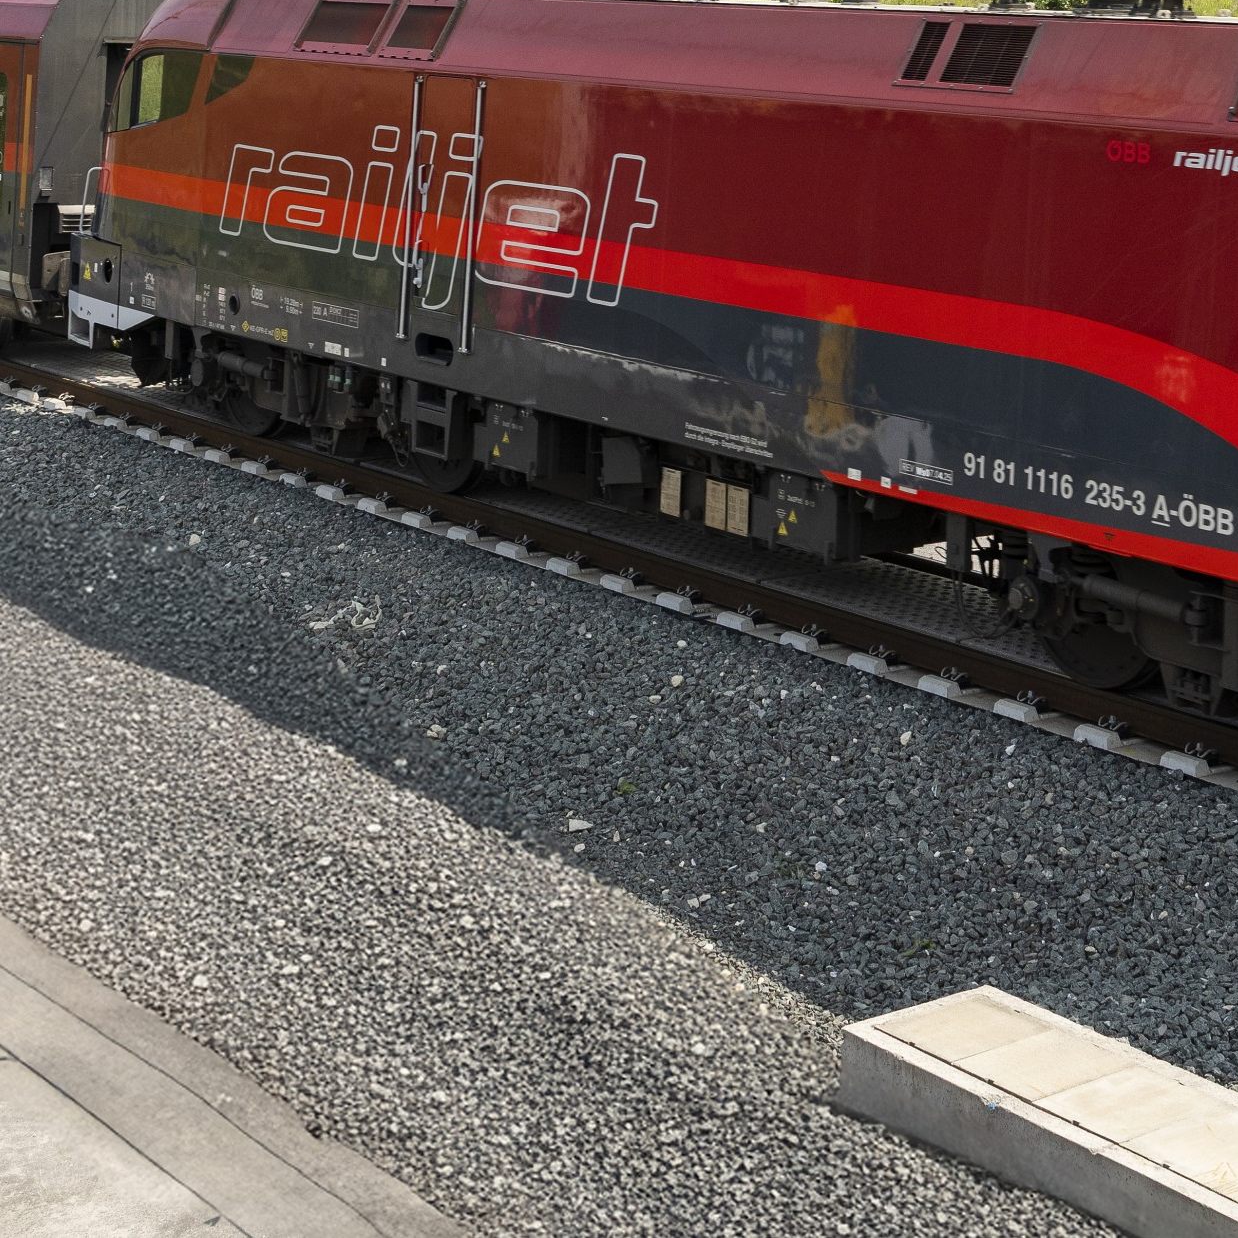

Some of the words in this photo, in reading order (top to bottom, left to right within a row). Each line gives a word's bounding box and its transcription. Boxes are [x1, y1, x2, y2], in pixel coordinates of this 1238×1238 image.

[1106, 139, 1150, 164] ÖBB
[219, 125, 658, 309] railjet
[251, 284, 264, 301] ÖBB
[963, 452, 986, 479] 91
[993, 459, 1016, 486] 81
[1024, 465, 1074, 500] 1116
[1085, 479, 1146, 516] 235-3
[1151, 493, 1235, 536] A-ÖBB
